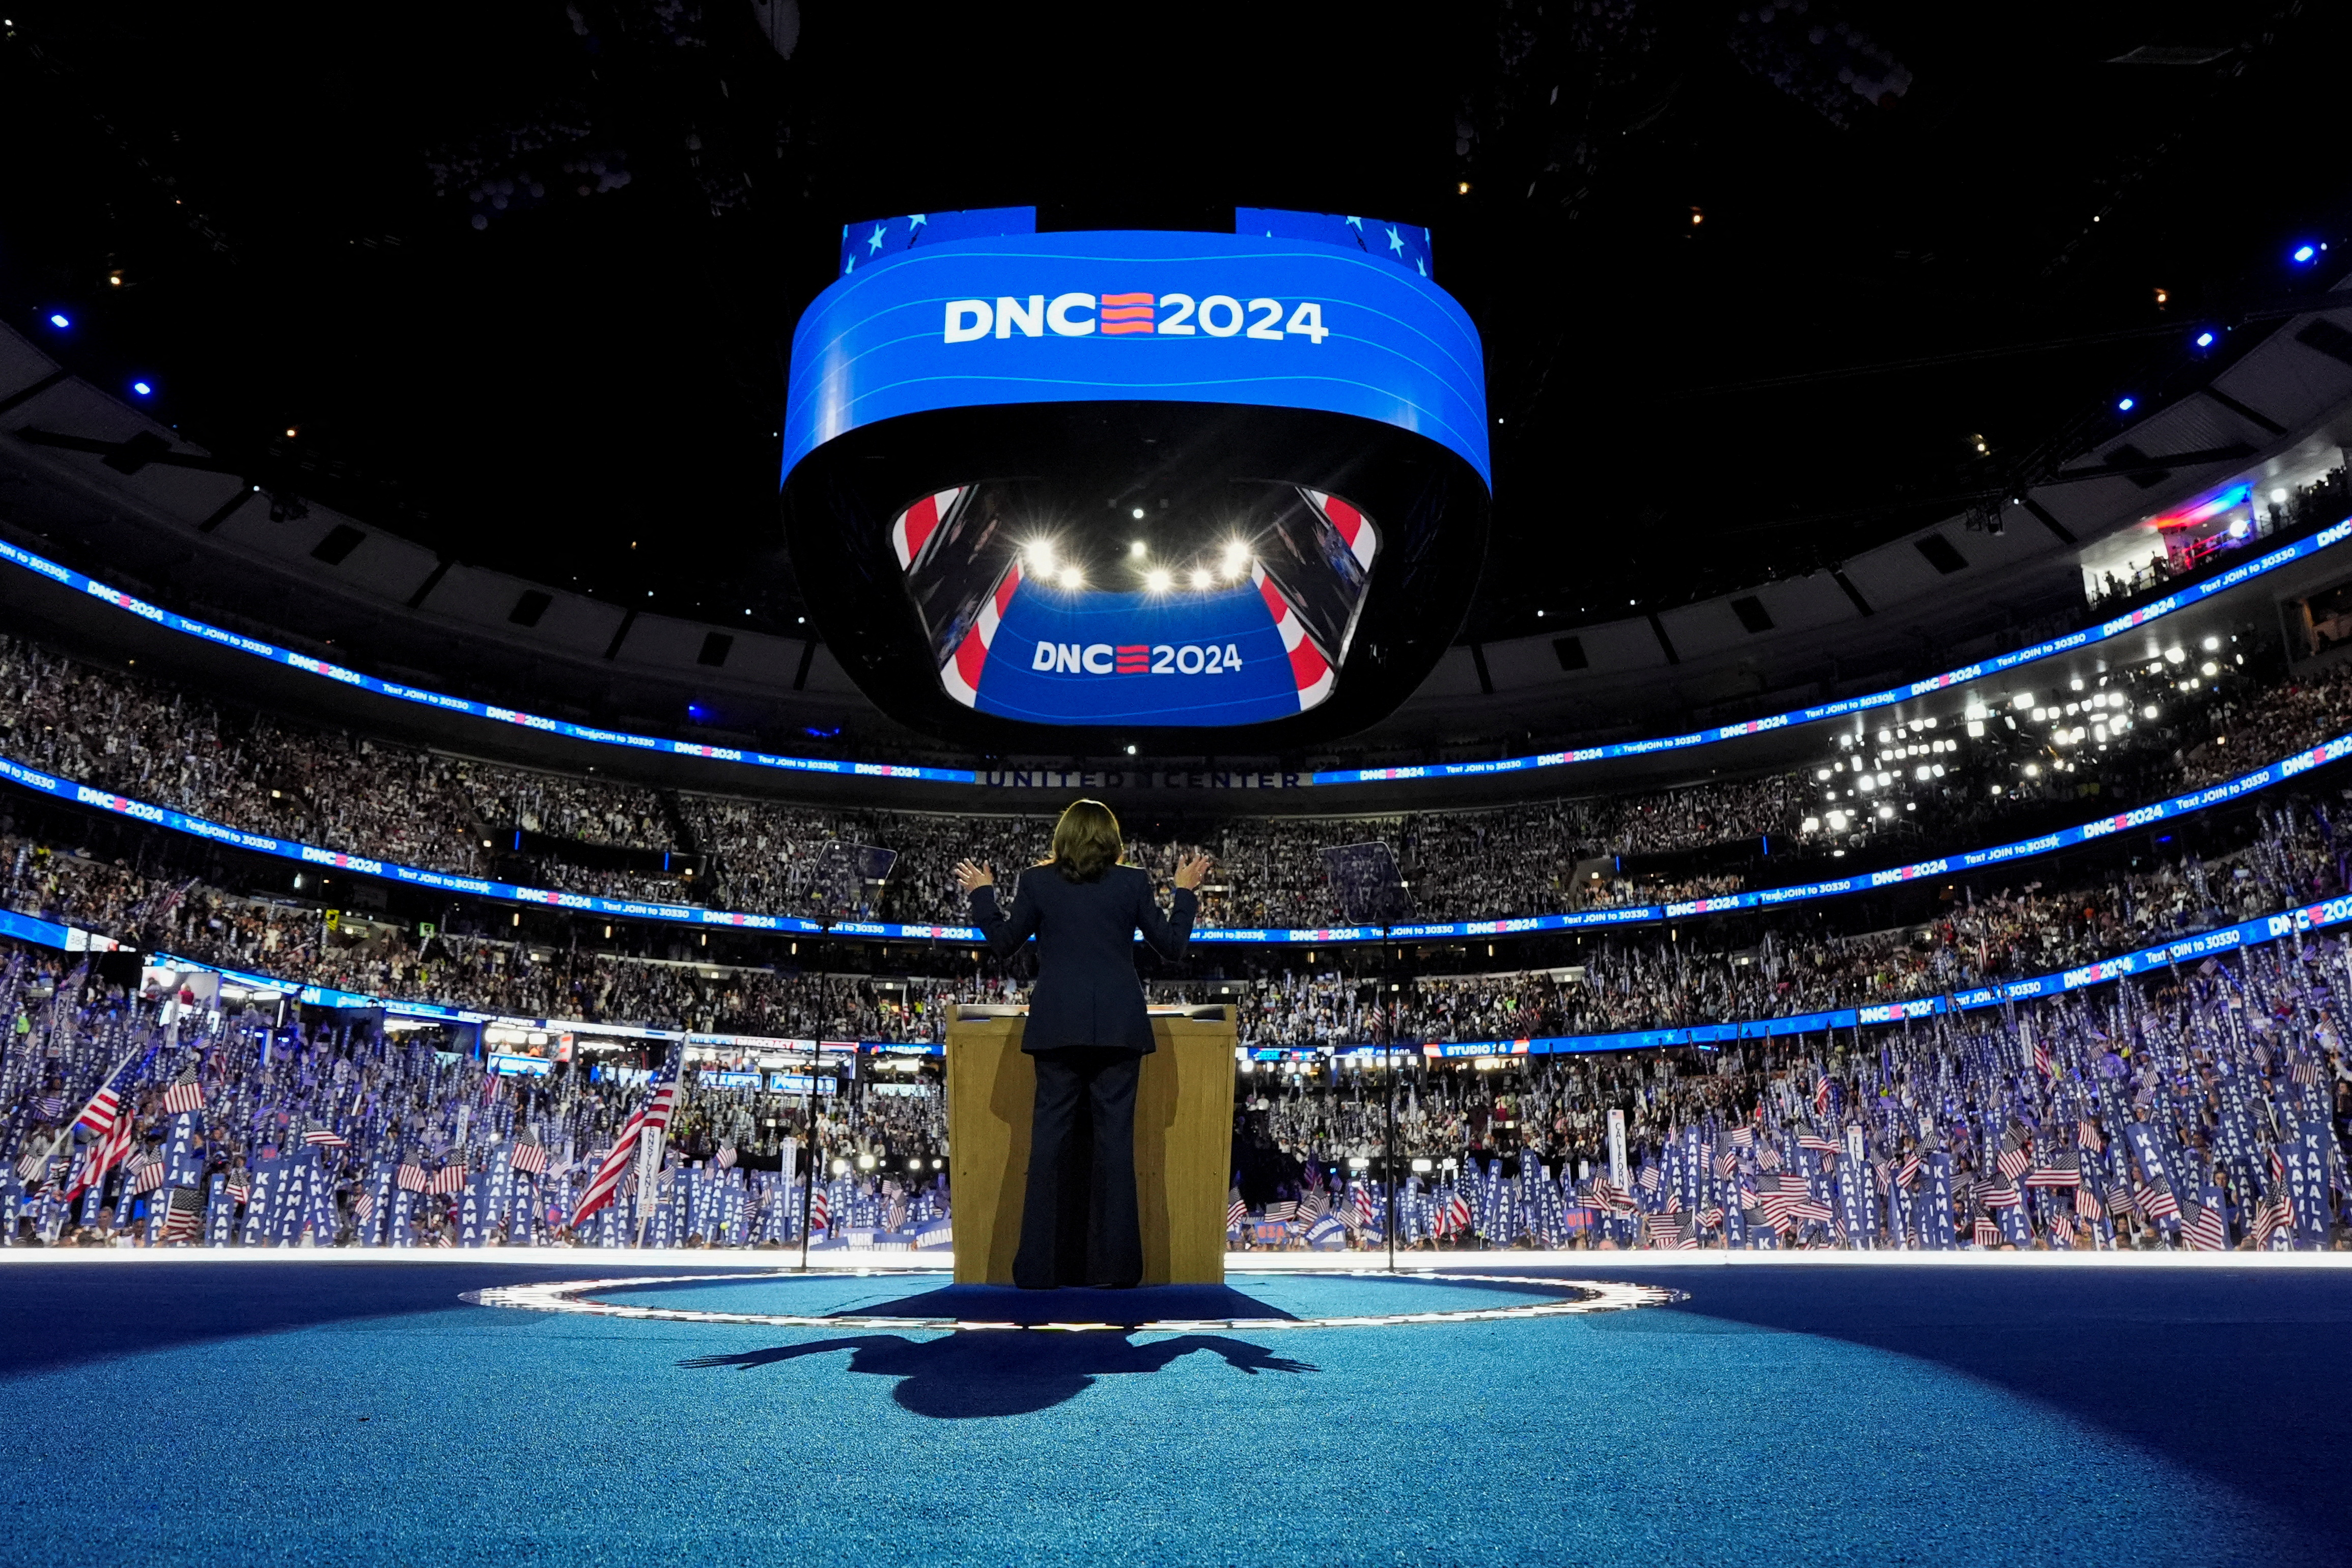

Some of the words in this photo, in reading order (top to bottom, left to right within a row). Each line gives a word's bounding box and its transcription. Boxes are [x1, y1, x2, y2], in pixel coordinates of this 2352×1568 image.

[944, 292, 1096, 344] DNC
[1158, 293, 1329, 344] 2024
[2317, 520, 2352, 546] DNC
[17, 552, 27, 562] to
[2200, 579, 2220, 592] Text
[2223, 568, 2247, 584] JOIN
[2249, 564, 2259, 572] to
[2262, 548, 2295, 568] 30330
[88, 581, 122, 603] DNC
[128, 599, 163, 621] 2024
[2103, 614, 2133, 636] DNC
[2141, 597, 2175, 620] 2024
[181, 620, 202, 632] Text
[204, 629, 228, 641] JOIN
[230, 636, 240, 645] to
[242, 639, 272, 655] 30330
[1998, 655, 2015, 665] Text
[2019, 648, 2041, 660] JOIN
[2055, 633, 2085, 649] 30330
[288, 653, 320, 671] DNC
[327, 665, 360, 683] 2024
[1032, 641, 1113, 674] DNC
[1152, 644, 1242, 674] 2024
[1911, 677, 1940, 695] DNC
[1948, 664, 1981, 684] 2024
[383, 684, 402, 694] Text
[404, 690, 427, 700] JOIN
[440, 697, 468, 709] 30330
[1806, 709, 1823, 717] Text
[1826, 703, 1847, 714] JOIN
[486, 706, 516, 722] DNC
[523, 715, 555, 730] 2024
[1720, 723, 1748, 738] DNC
[1756, 715, 1787, 731] 2024
[628, 736, 654, 746] 30330
[675, 742, 703, 755] DNC
[710, 747, 741, 760] 2024
[1675, 735, 1701, 745] 30330
[855, 763, 883, 775] DNC
[889, 766, 920, 777] 2024
[1537, 753, 1564, 766] DNC
[1573, 748, 1603, 761] 2024
[2281, 751, 2315, 776] DNC
[11, 767, 20, 777] to
[22, 770, 55, 789] 30330
[986, 771, 1124, 788] UNITED
[1164, 772, 1300, 788] CENTER
[1360, 769, 1387, 780] DNC
[1394, 767, 1424, 778] 2024
[77, 787, 116, 808] DNC
[124, 801, 163, 822] 2024
[2176, 796, 2199, 808] Text
[2202, 787, 2227, 803] JOIN
[2229, 785, 2239, 793] to
[2241, 771, 2269, 790] 30330
[2083, 818, 2116, 838] DNC
[2125, 804, 2163, 826] 2024
[230, 833, 240, 842] to
[242, 835, 276, 850] 30330
[1965, 853, 1985, 863] Text
[1988, 848, 2012, 860] JOIN
[2027, 835, 2058, 852] 30330
[302, 847, 338, 864] DNC
[345, 856, 382, 874] 2024
[1872, 869, 1902, 885] DNC
[1912, 859, 1947, 877] 2024
[398, 869, 417, 879] Text
[418, 874, 441, 884] JOIN
[1782, 888, 1805, 898] JOIN
[1819, 881, 1850, 893] 30330
[516, 887, 548, 902] DNC
[556, 893, 592, 908] 2024
[602, 901, 621, 911] Text
[623, 905, 646, 913] JOIN
[659, 907, 690, 918] 30330
[1666, 902, 1696, 916] DNC
[1705, 895, 1739, 911] 2024
[703, 911, 735, 924] DNC
[742, 915, 776, 928] 2024
[1425, 926, 1453, 934] 30330
[1467, 921, 1497, 934] DNC
[1505, 918, 1538, 931] 2024
[1583, 913, 1606, 922] JOIN
[1619, 909, 1648, 919] 30330
[902, 926, 932, 937] DNC
[939, 927, 973, 938] 2024
[1290, 930, 1319, 940] DNC
[1327, 928, 1360, 940] 2024
[2145, 950, 2166, 963] Text
[2169, 942, 2192, 957] OIN
[2193, 941, 2204, 951] to
[2206, 930, 2239, 949] 30330
[2009, 981, 2040, 997] 30330
[2063, 967, 2092, 988] DNC
[1446, 1044, 1490, 1056] STUDIO
[2230, 1085, 2249, 1139] KAMALA
[2282, 1101, 2301, 1139] KAMA
[169, 1113, 190, 1181] AMALA
[2224, 1121, 2239, 1156] KAMA
[643, 1126, 652, 1200] ENNSYLVANIA
[1614, 1122, 1625, 1189] CALIFORN
[1688, 1133, 1697, 1198] KAMALA
[2114, 1149, 2127, 1186] KAMA
[2136, 1132, 2165, 1177] KAM
[486, 1151, 508, 1221] KAMALA
[1484, 1166, 1499, 1217] KAMALA
[1523, 1155, 1533, 1201] KAMALA
[2189, 1161, 2200, 1201] KAMA
[2305, 1134, 2323, 1233] KAMALA
[244, 1172, 271, 1243] KAMAL
[371, 1173, 393, 1243] KAMALA
[514, 1172, 530, 1236] AMALA
[1839, 1161, 1860, 1231] KAMALA
[1864, 1168, 1875, 1230] KAMALA
[1934, 1165, 1949, 1244] KAMAL
[2238, 1165, 2252, 1228] KAMALA
[462, 1184, 477, 1248] KAMA
[1499, 1185, 1510, 1242] KAMALA
[1257, 1225, 1283, 1239] USA
